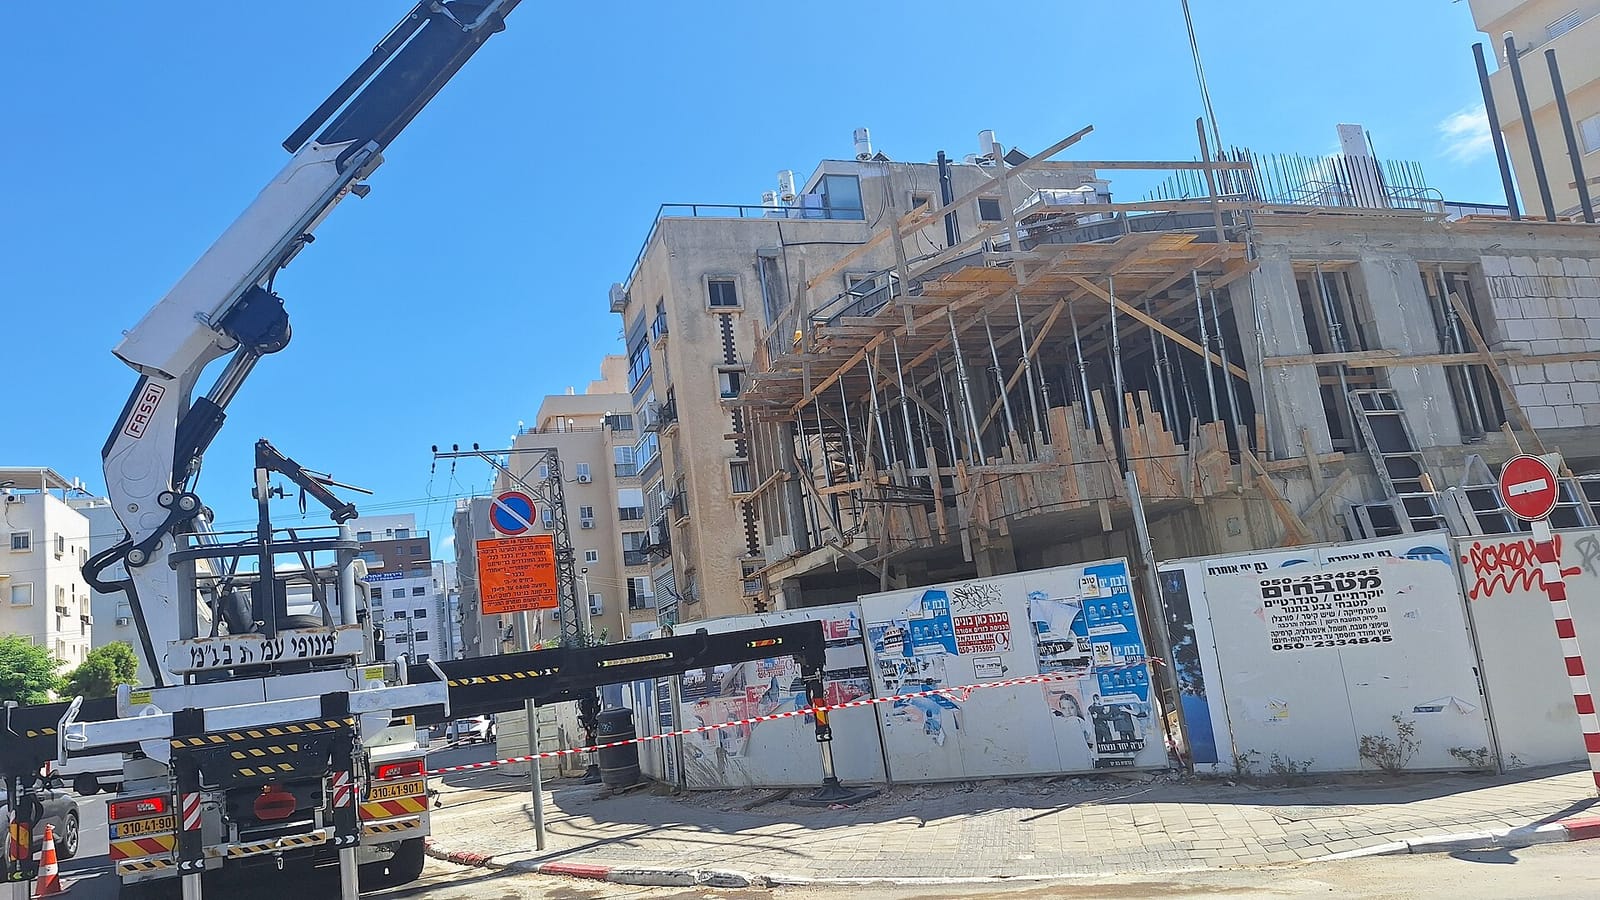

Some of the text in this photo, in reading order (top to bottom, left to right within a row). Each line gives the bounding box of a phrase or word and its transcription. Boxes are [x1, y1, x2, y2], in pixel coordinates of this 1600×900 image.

[130, 388, 161, 433] FASSI
[1082, 576, 1095, 585] טוב
[1261, 576, 1382, 599] מטבחים
[1333, 589, 1384, 602] יוקרתיים
[1281, 599, 1368, 613] מטבחי צבע בתנור
[955, 617, 973, 626] בונים
[989, 613, 1007, 623] סכנה
[1319, 611, 1336, 619] שיש
[291, 634, 335, 658] מנופי
[1271, 635, 1393, 651] 050-2334845
